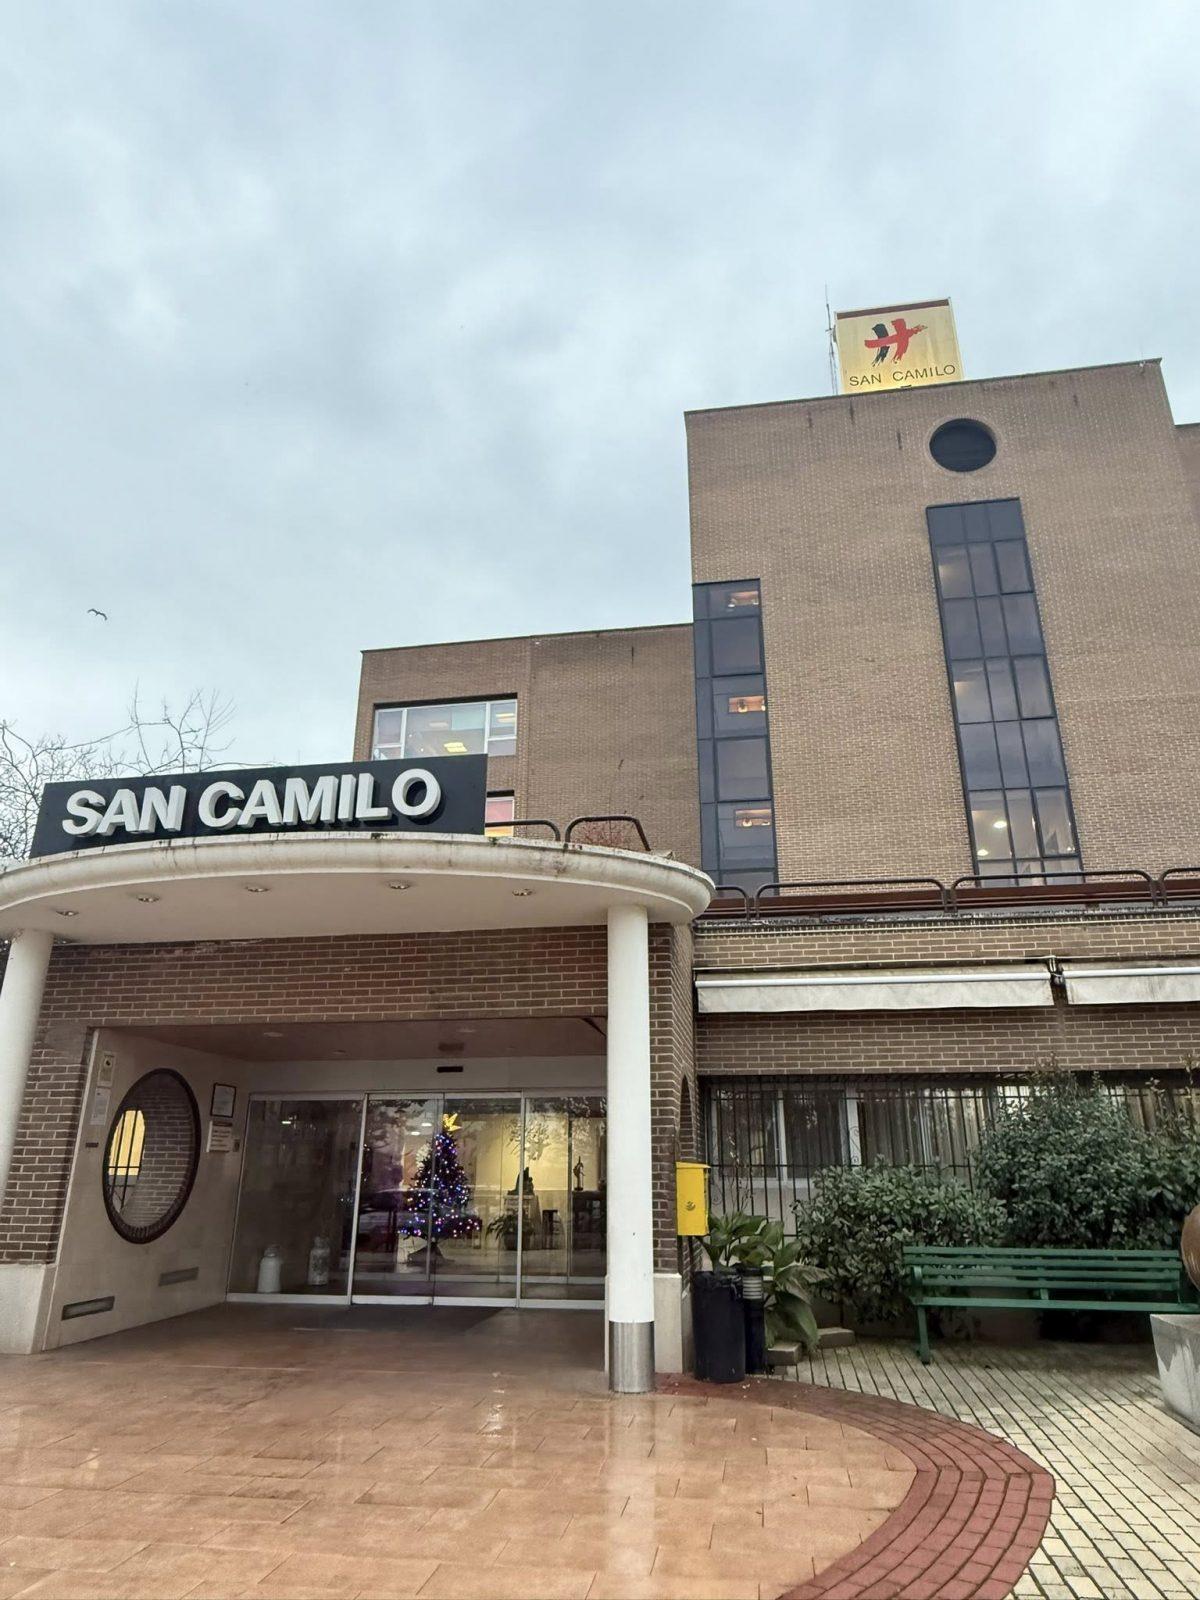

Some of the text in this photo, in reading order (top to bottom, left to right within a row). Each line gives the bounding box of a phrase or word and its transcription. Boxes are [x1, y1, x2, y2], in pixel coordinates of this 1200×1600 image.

[849, 364, 956, 387] SAN CAMILO
[62, 768, 441, 837] SAN CAMILO
